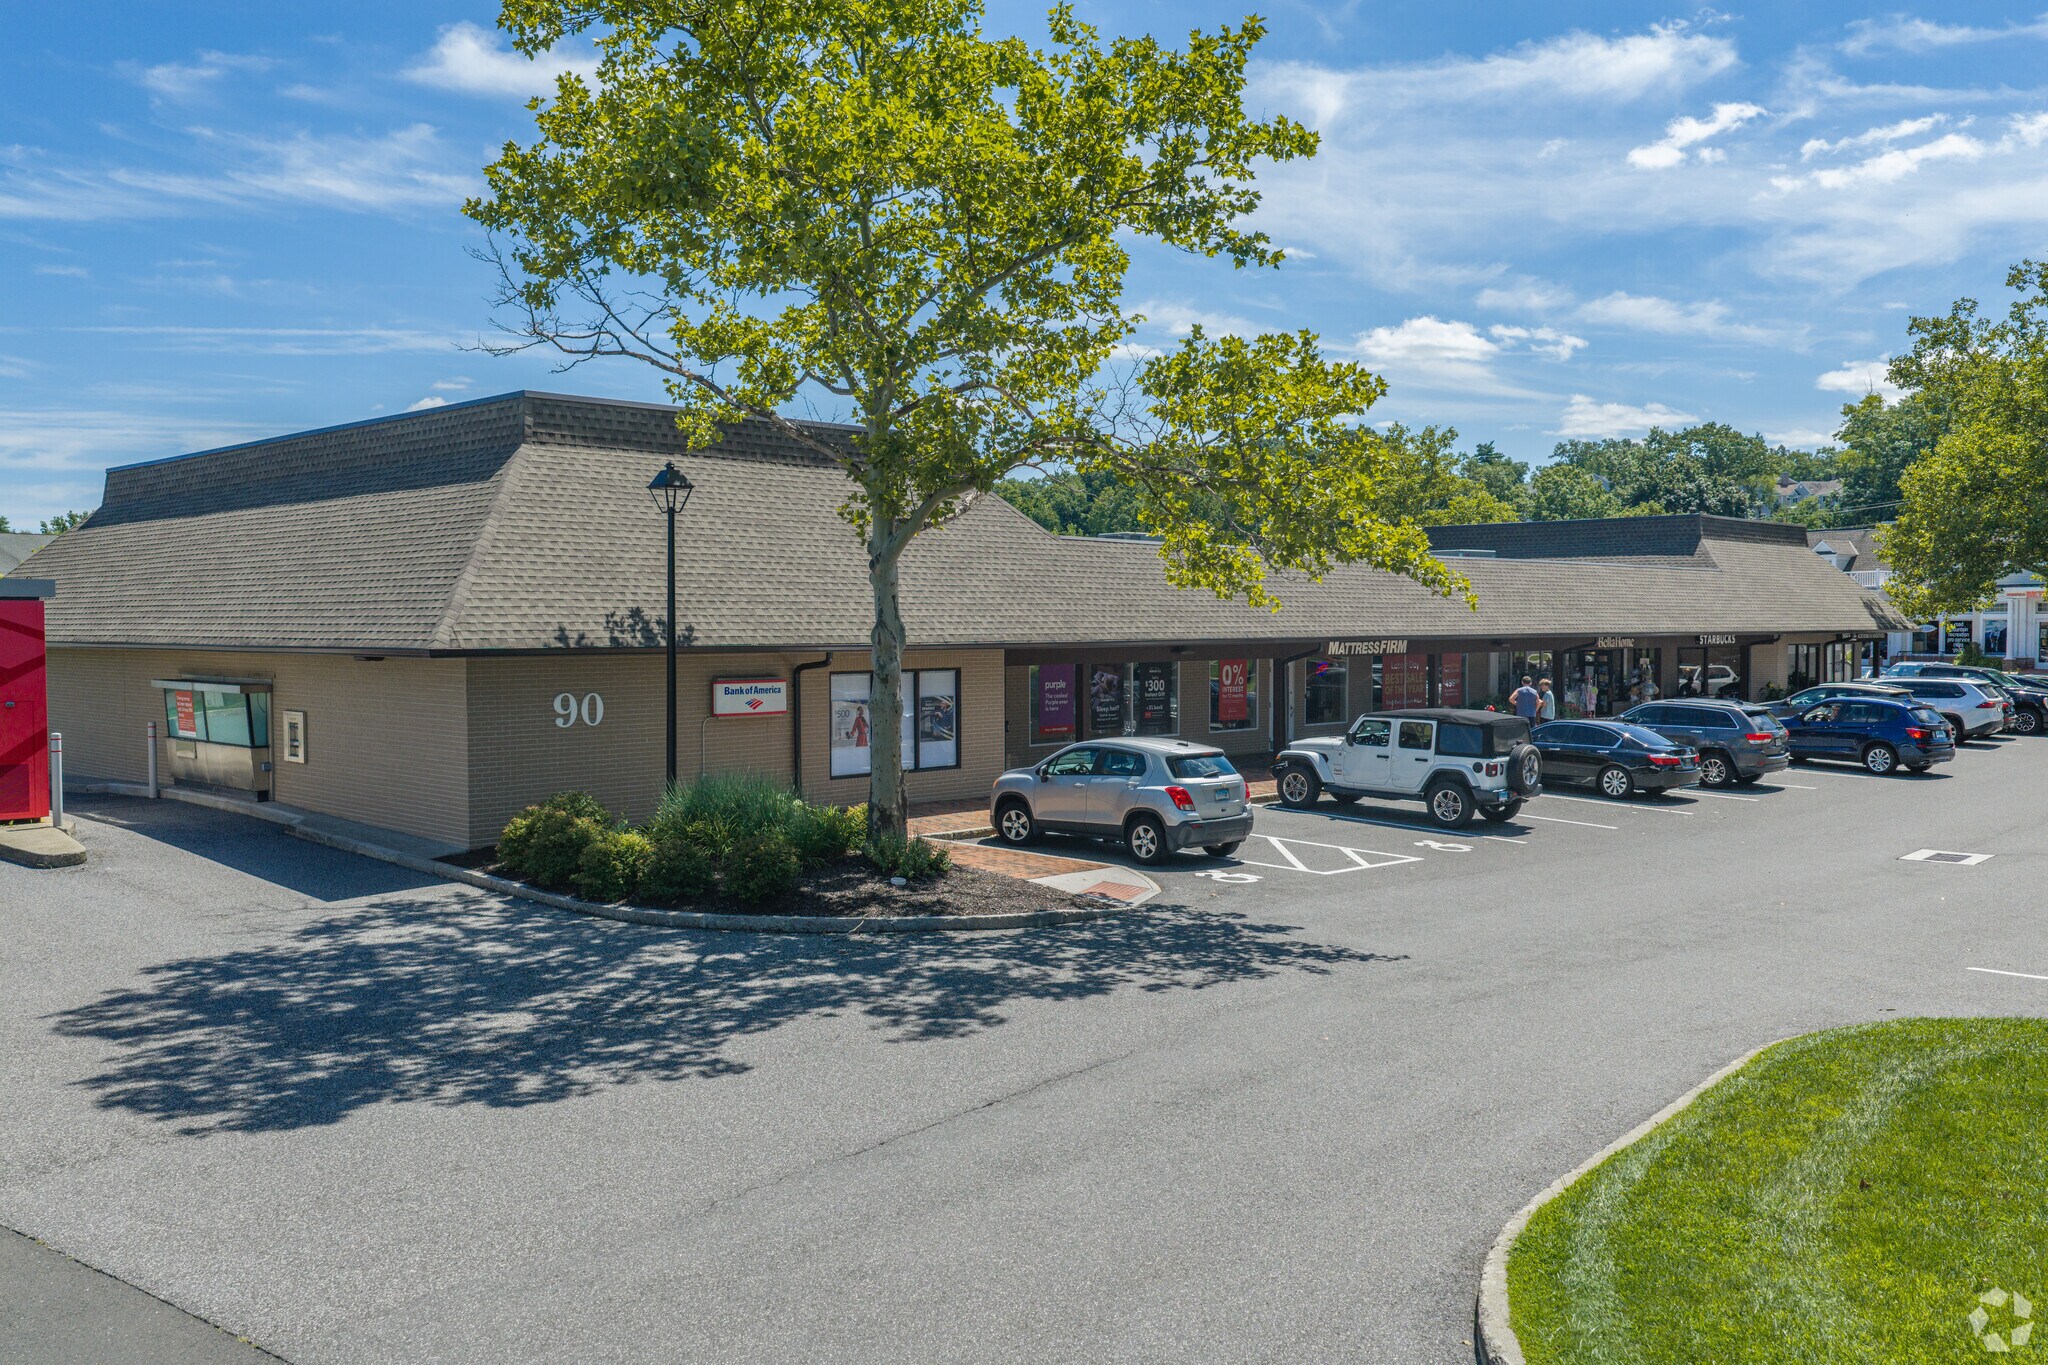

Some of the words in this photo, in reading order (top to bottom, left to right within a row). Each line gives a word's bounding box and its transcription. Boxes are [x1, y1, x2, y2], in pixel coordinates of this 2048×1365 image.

[1699, 634, 1736, 645] STARBUCKS
[1222, 663, 1244, 686] 0%
[1384, 673, 1404, 685] BEST
[1407, 672, 1424, 684] SALE
[724, 686, 745, 695] Bank
[745, 686, 753, 694] of
[753, 685, 781, 694] America
[1045, 680, 1066, 690] purple
[1145, 680, 1165, 691] $300
[1384, 685, 1394, 695] OF
[1408, 684, 1424, 693] YEAR
[553, 692, 604, 728] 90
[1096, 705, 1109, 713] Sleep
